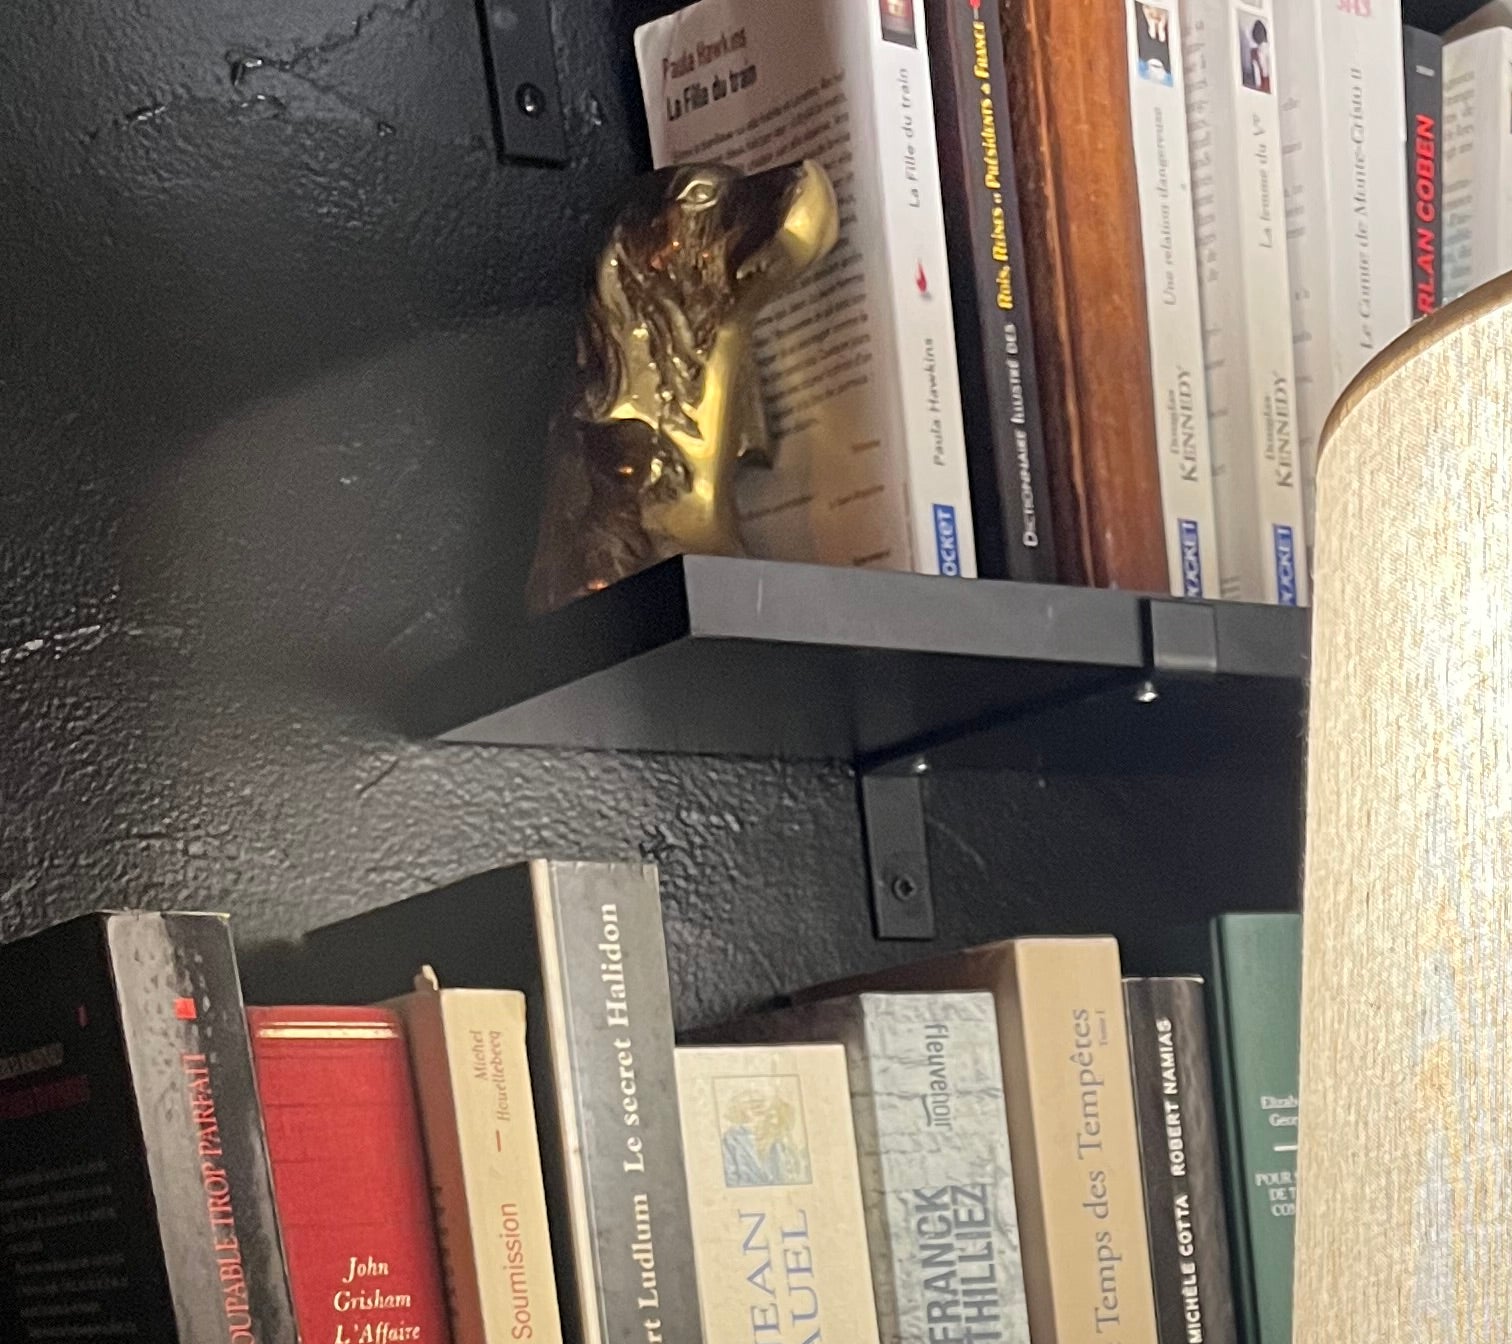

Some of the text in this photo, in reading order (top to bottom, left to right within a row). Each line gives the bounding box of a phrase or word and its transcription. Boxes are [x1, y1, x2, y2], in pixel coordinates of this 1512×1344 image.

[899, 68, 920, 208] La Fille du train
[1153, 106, 1171, 199] dangereuse
[1349, 90, 1369, 217] Monte-Cristo
[1159, 204, 1176, 264] relation
[1254, 144, 1273, 249] La femme du
[1354, 230, 1370, 249] de
[1415, 114, 1436, 314] RLAN COBEN
[922, 337, 944, 466] Paula Hawkins
[1176, 365, 1198, 482] KENNEDY
[1271, 370, 1294, 488] KENNEDY
[937, 508, 959, 577] OCKET
[597, 902, 630, 1029] Halidon
[180, 1053, 223, 1157] PARFAIT
[468, 1029, 490, 1080] Michel
[488, 1029, 511, 1122] Houellebecq
[611, 1036, 640, 1128] secret
[1068, 1007, 1105, 1161] Tempêtes
[202, 1162, 235, 1228] TROP
[622, 1135, 647, 1174] Le
[1081, 1170, 1110, 1220] des
[1155, 1016, 1204, 1344] MICHÈLE COTTA ROBERT NAMIAS
[333, 1288, 411, 1312] Grisham
[342, 1255, 389, 1284] John
[499, 1202, 533, 1339] Soumission
[631, 1192, 660, 1309] Ludlum
[1095, 1230, 1123, 1335] Temps
